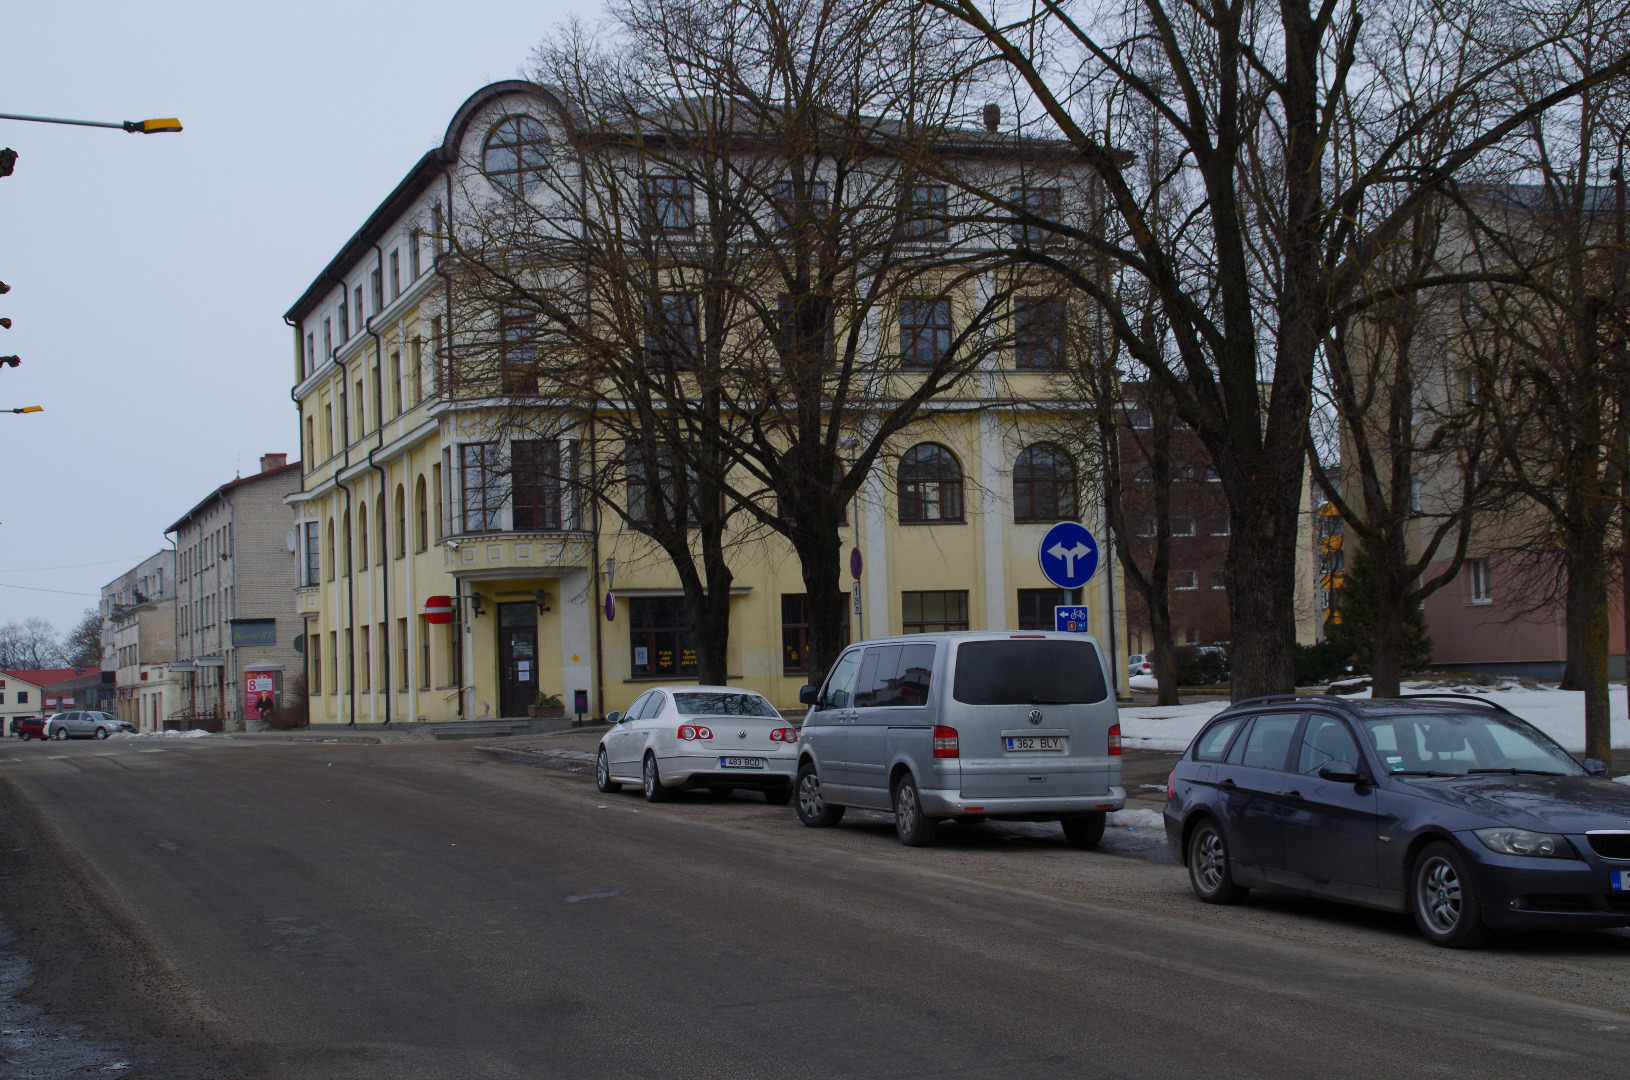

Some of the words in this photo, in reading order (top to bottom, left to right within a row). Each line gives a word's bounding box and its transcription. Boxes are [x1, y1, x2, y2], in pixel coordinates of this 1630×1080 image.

[249, 680, 256, 690] 8
[1016, 739, 1034, 749] 362
[1040, 738, 1059, 748] BLY
[744, 758, 760, 766] BCD
